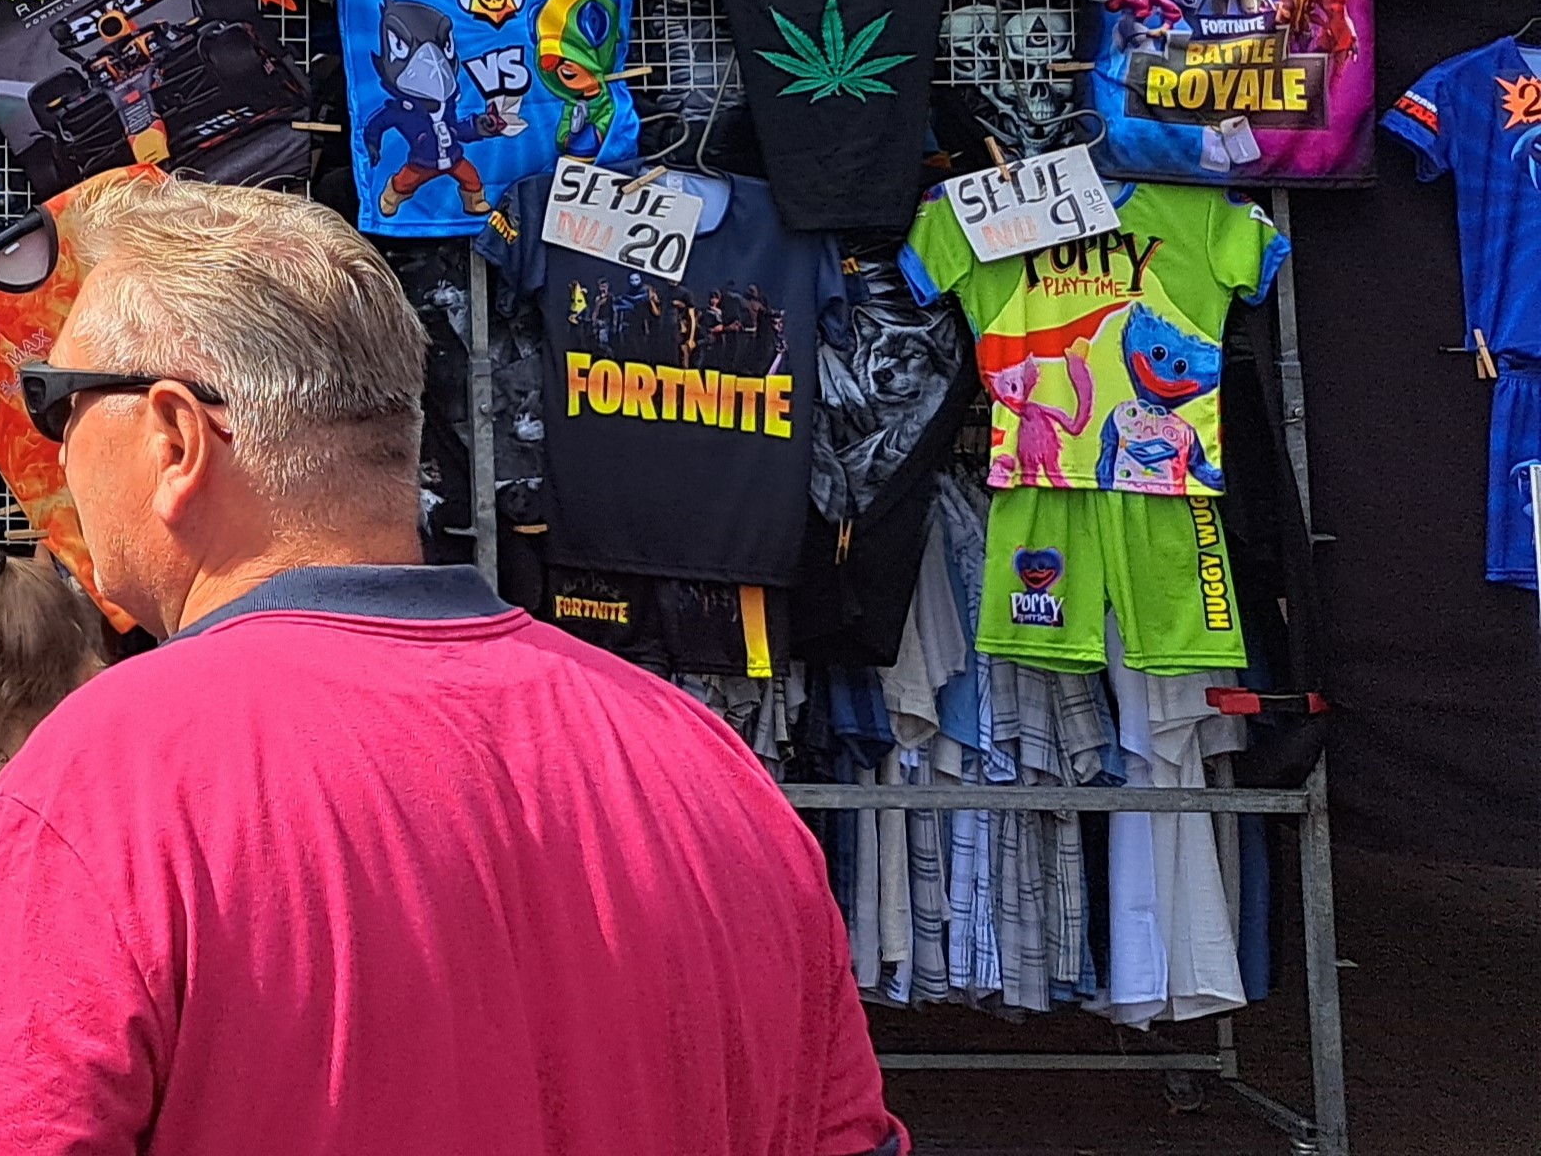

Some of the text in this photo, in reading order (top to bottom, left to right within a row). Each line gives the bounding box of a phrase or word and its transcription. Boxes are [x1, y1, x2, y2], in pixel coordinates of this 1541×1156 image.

[1200, 16, 1266, 35] FORTNITE
[468, 47, 530, 90] VS
[1185, 38, 1276, 66] BATTLE
[1146, 65, 1308, 111] ROYALE
[553, 165, 676, 219] SETJE
[957, 157, 1075, 224] SETJE
[618, 223, 687, 274] 20
[566, 351, 793, 439] FORTNITE
[554, 595, 630, 624] FORTNITE
[1011, 592, 1064, 622] POPPY
[1201, 554, 1231, 629] HUGGY
